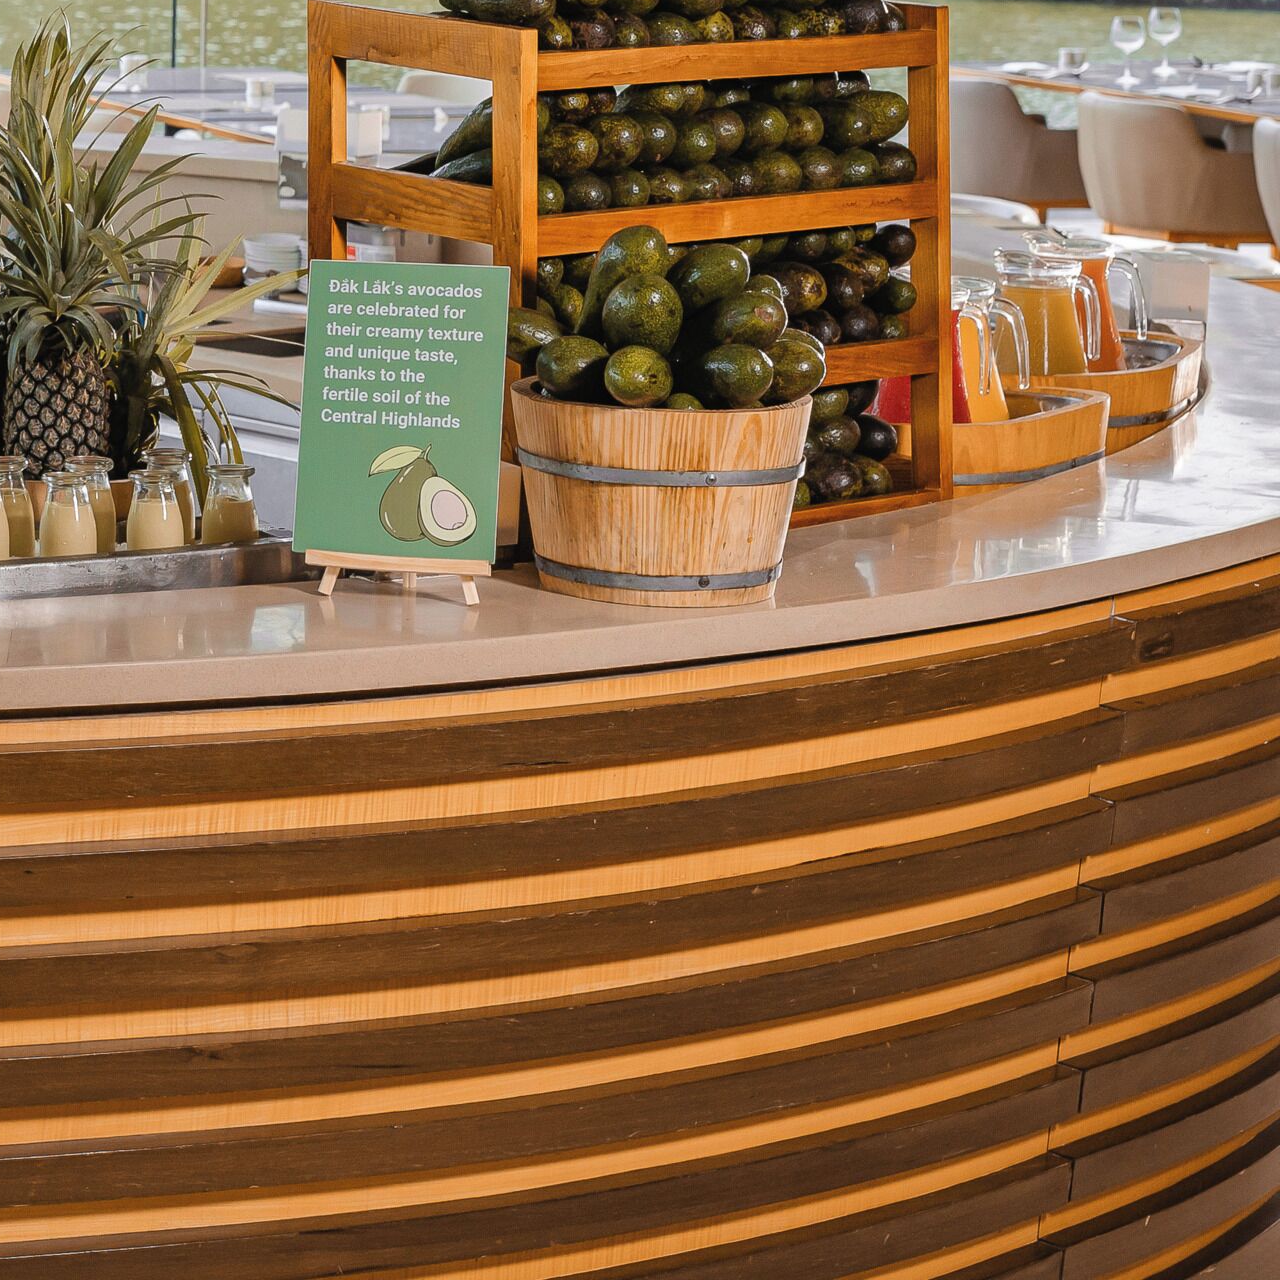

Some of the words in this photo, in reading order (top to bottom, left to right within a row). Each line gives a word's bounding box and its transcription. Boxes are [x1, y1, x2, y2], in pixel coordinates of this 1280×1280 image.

[408, 284, 483, 298] avocados
[328, 304, 352, 315] are
[357, 302, 439, 318] celebrated
[443, 305, 466, 319] for
[326, 322, 362, 336] their
[366, 325, 424, 342] creamy
[428, 327, 483, 342] texture
[325, 344, 353, 358] and
[358, 346, 410, 363] unique
[415, 348, 458, 365] taste,
[323, 365, 376, 380] thanks
[380, 368, 396, 381] to
[400, 369, 425, 383] the
[322, 387, 368, 402] fertile
[372, 389, 400, 403] soil
[404, 391, 421, 404] of
[425, 392, 450, 406] the
[321, 409, 377, 424] Central
[381, 412, 460, 429] Highlands
